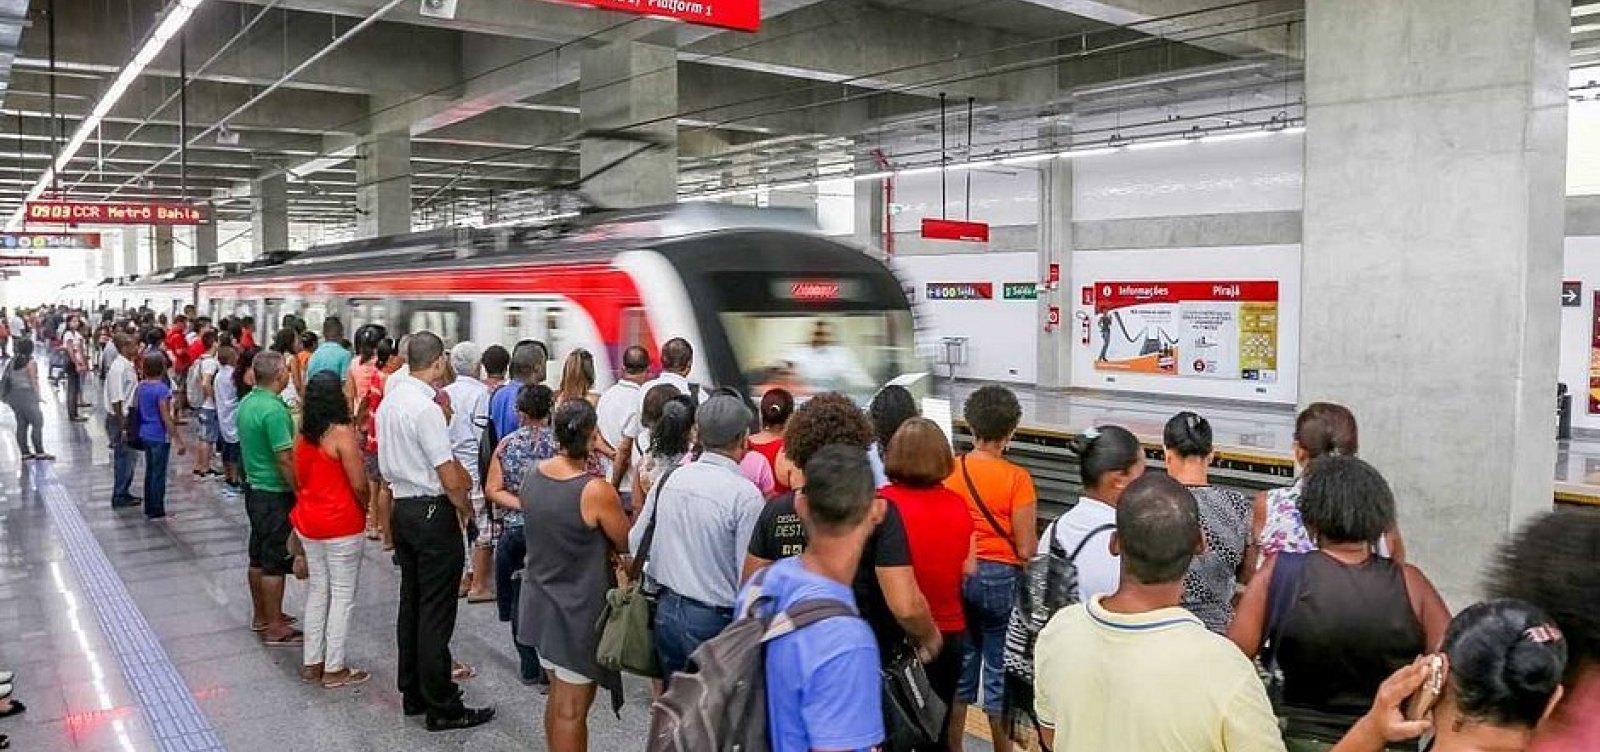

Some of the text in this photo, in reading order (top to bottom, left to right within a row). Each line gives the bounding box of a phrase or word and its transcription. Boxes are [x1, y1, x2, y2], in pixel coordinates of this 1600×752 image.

[73, 205, 100, 218] CCR
[1118, 284, 1240, 297] Informações Pirajá
